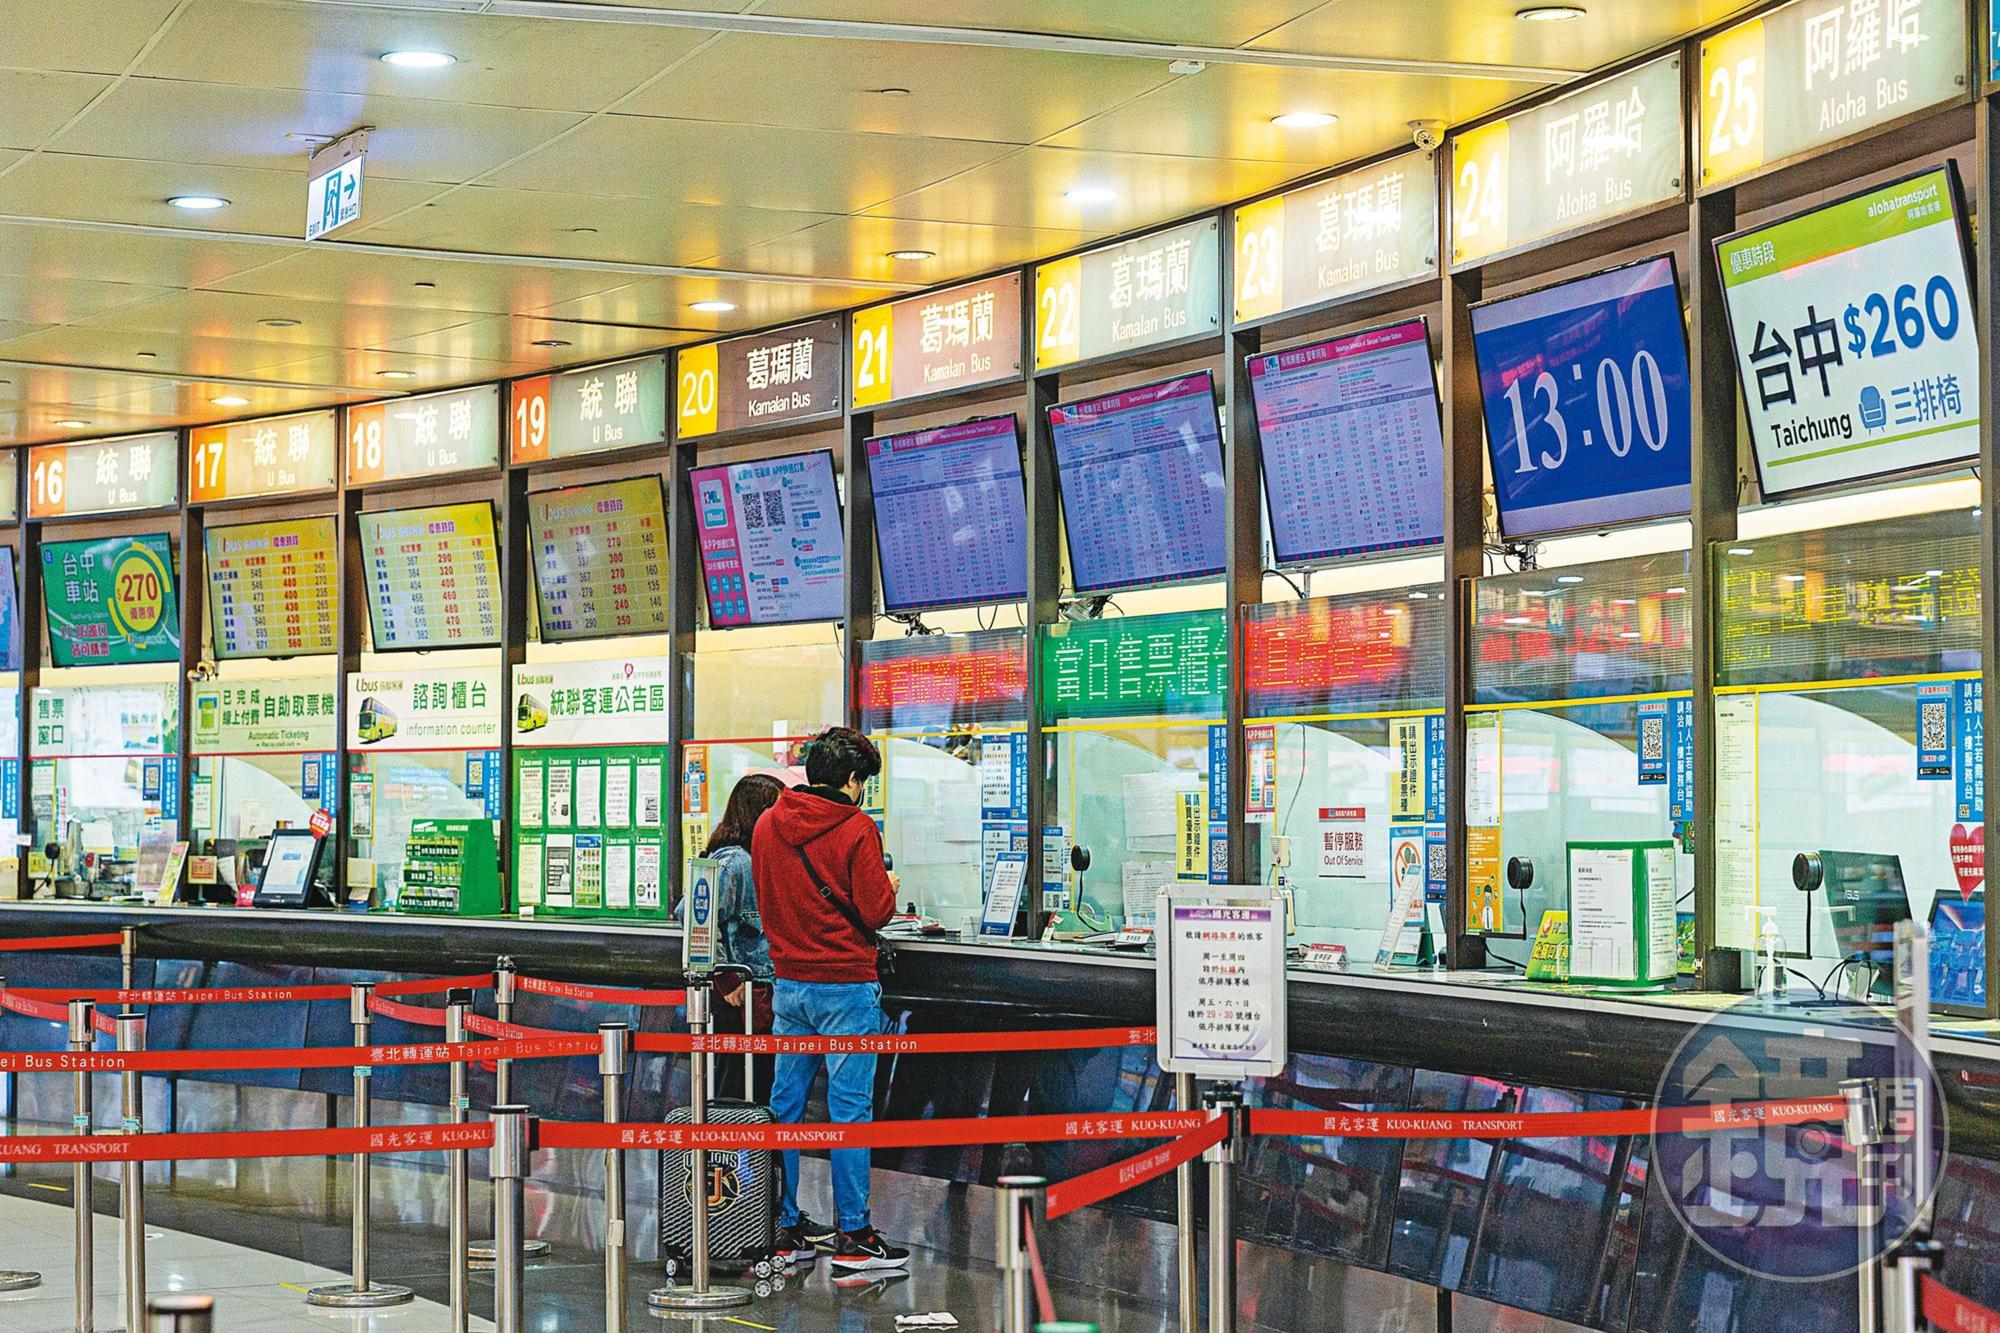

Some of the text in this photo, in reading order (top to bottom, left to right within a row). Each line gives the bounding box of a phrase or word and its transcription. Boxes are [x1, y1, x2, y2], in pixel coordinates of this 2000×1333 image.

[1708, 56, 1757, 157] 25
[1819, 76, 1908, 131] Aloha Bus
[1545, 86, 1645, 185] 阿羅哈
[1460, 151, 1501, 240] 24
[1557, 177, 1632, 221] Aloha Bus
[1868, 183, 1938, 217] alohatransport
[1315, 171, 1404, 253] 葛瑪蘭
[309, 221, 320, 236] EXIT
[1109, 238, 1191, 309] 葛瑪蘭
[1241, 225, 1277, 300] 23
[1318, 249, 1399, 290] Kamalan Bus
[1730, 244, 1776, 274] 優惠時段
[920, 291, 995, 355] 葛瑪蘭
[1042, 282, 1075, 349] 22
[1112, 307, 1186, 342] Kamalan Bus
[858, 325, 888, 388] 21
[1749, 275, 1959, 411] 台中 $260
[746, 336, 814, 391] 葛瑪蘭
[923, 355, 991, 384] Kamalan Bus
[578, 370, 639, 422] 統聯
[682, 368, 715, 418] 20
[749, 390, 811, 418] Kamalan Bus
[1891, 373, 1961, 425] 三排椅
[415, 400, 472, 445] 統聯
[516, 395, 546, 449] 19
[1503, 350, 1668, 473] 13:00
[592, 424, 624, 444] U Bus
[1771, 411, 1852, 448] Taichung
[253, 424, 311, 466] 統聯
[352, 420, 381, 470] 18
[427, 449, 458, 467] U Bus
[95, 443, 152, 485] 統聯
[195, 442, 224, 489] 17
[267, 468, 296, 486] U Bus
[33, 460, 64, 505] 16
[107, 486, 138, 503] U Bus
[63, 551, 95, 576] 台中
[440, 566, 453, 575] 320
[64, 578, 156, 620] 車站 優惠價
[284, 591, 297, 599] 400
[287, 615, 299, 623] 430
[446, 616, 460, 625] 470
[448, 629, 461, 638] 375
[37, 698, 64, 720] 售票
[223, 690, 260, 706] 已完成
[263, 693, 335, 718] 自助取票機
[413, 680, 487, 711] 諮詢櫃台
[550, 684, 665, 716] 統聯客運公告區
[222, 709, 260, 726] 線上付費
[460, 723, 496, 735] counter
[37, 725, 64, 746] 窗口
[248, 730, 310, 742] Automatic Ticketing
[1323, 831, 1363, 851] 暫停服務
[1323, 855, 1364, 866] Out Of Service
[1212, 909, 1251, 920] 國光客運
[181, 991, 219, 1002] Taipei
[224, 990, 244, 1000] Bus
[247, 988, 293, 1000] Station
[370, 1040, 600, 1063] 臺北轉運站 Taipei Bus Statio
[691, 1036, 918, 1053] 臺北轉運站 Taipei Bus Station
[25, 1054, 53, 1068] Bus
[60, 1054, 126, 1068] Station
[1065, 1118, 1201, 1135] 國光客運 KUO-KUANG
[1323, 1116, 1524, 1132] 國光客運 KUO-KUANG TRANSPORT
[1713, 1103, 1834, 1123] 國光客運 KUO-KUANG
[52, 1142, 130, 1156] TRANSPORT
[370, 1130, 434, 1147] 國光客運
[621, 1129, 845, 1144] 國光客運 KUO-KUANG TRANSPORT
